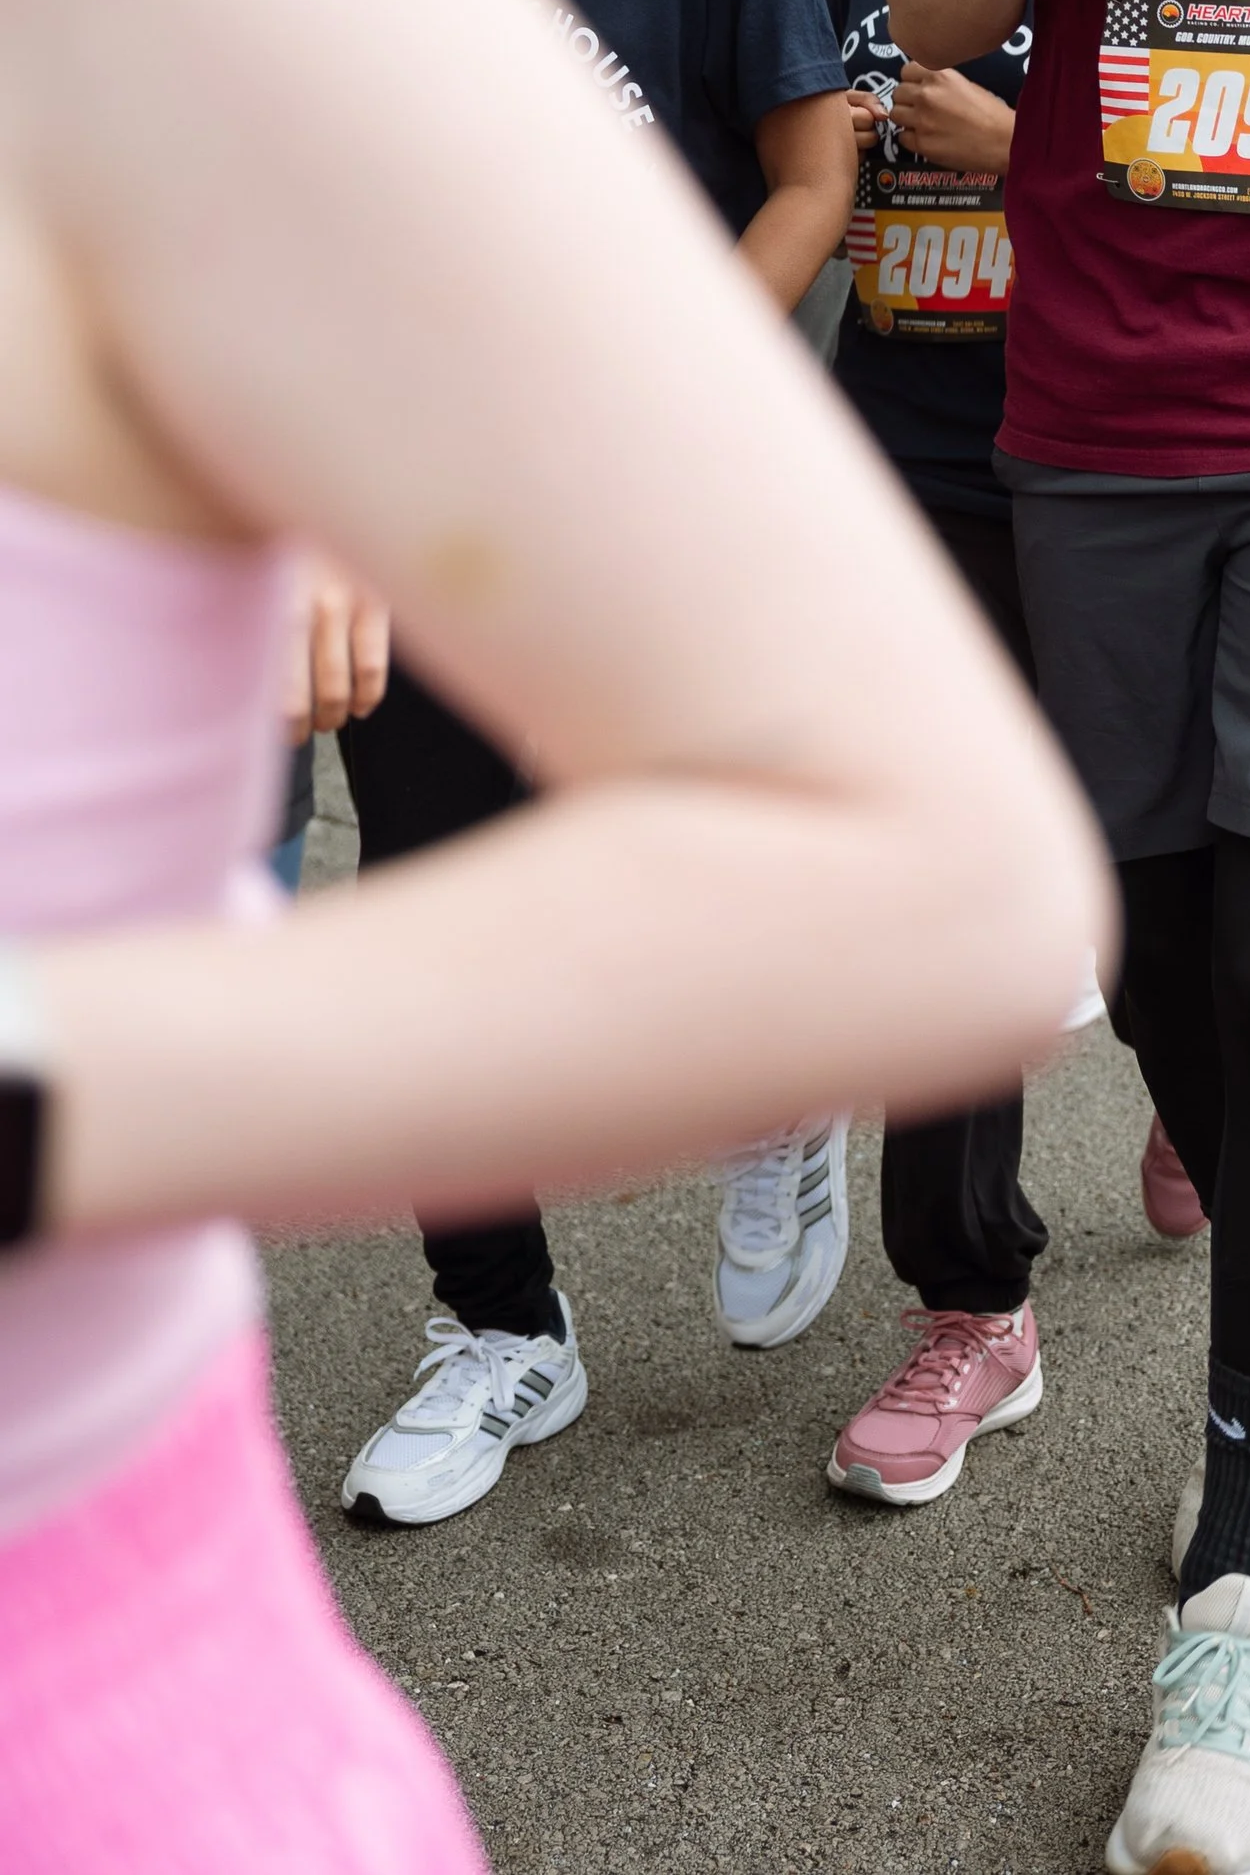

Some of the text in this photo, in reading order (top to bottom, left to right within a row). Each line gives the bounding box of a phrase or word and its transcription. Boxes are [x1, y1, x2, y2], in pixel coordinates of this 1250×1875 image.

[1175, 32, 1195, 44] GOD.
[1197, 33, 1236, 46] COUNTRY.
[898, 171, 998, 186] HEARTLAND
[878, 225, 1012, 299] 2094
